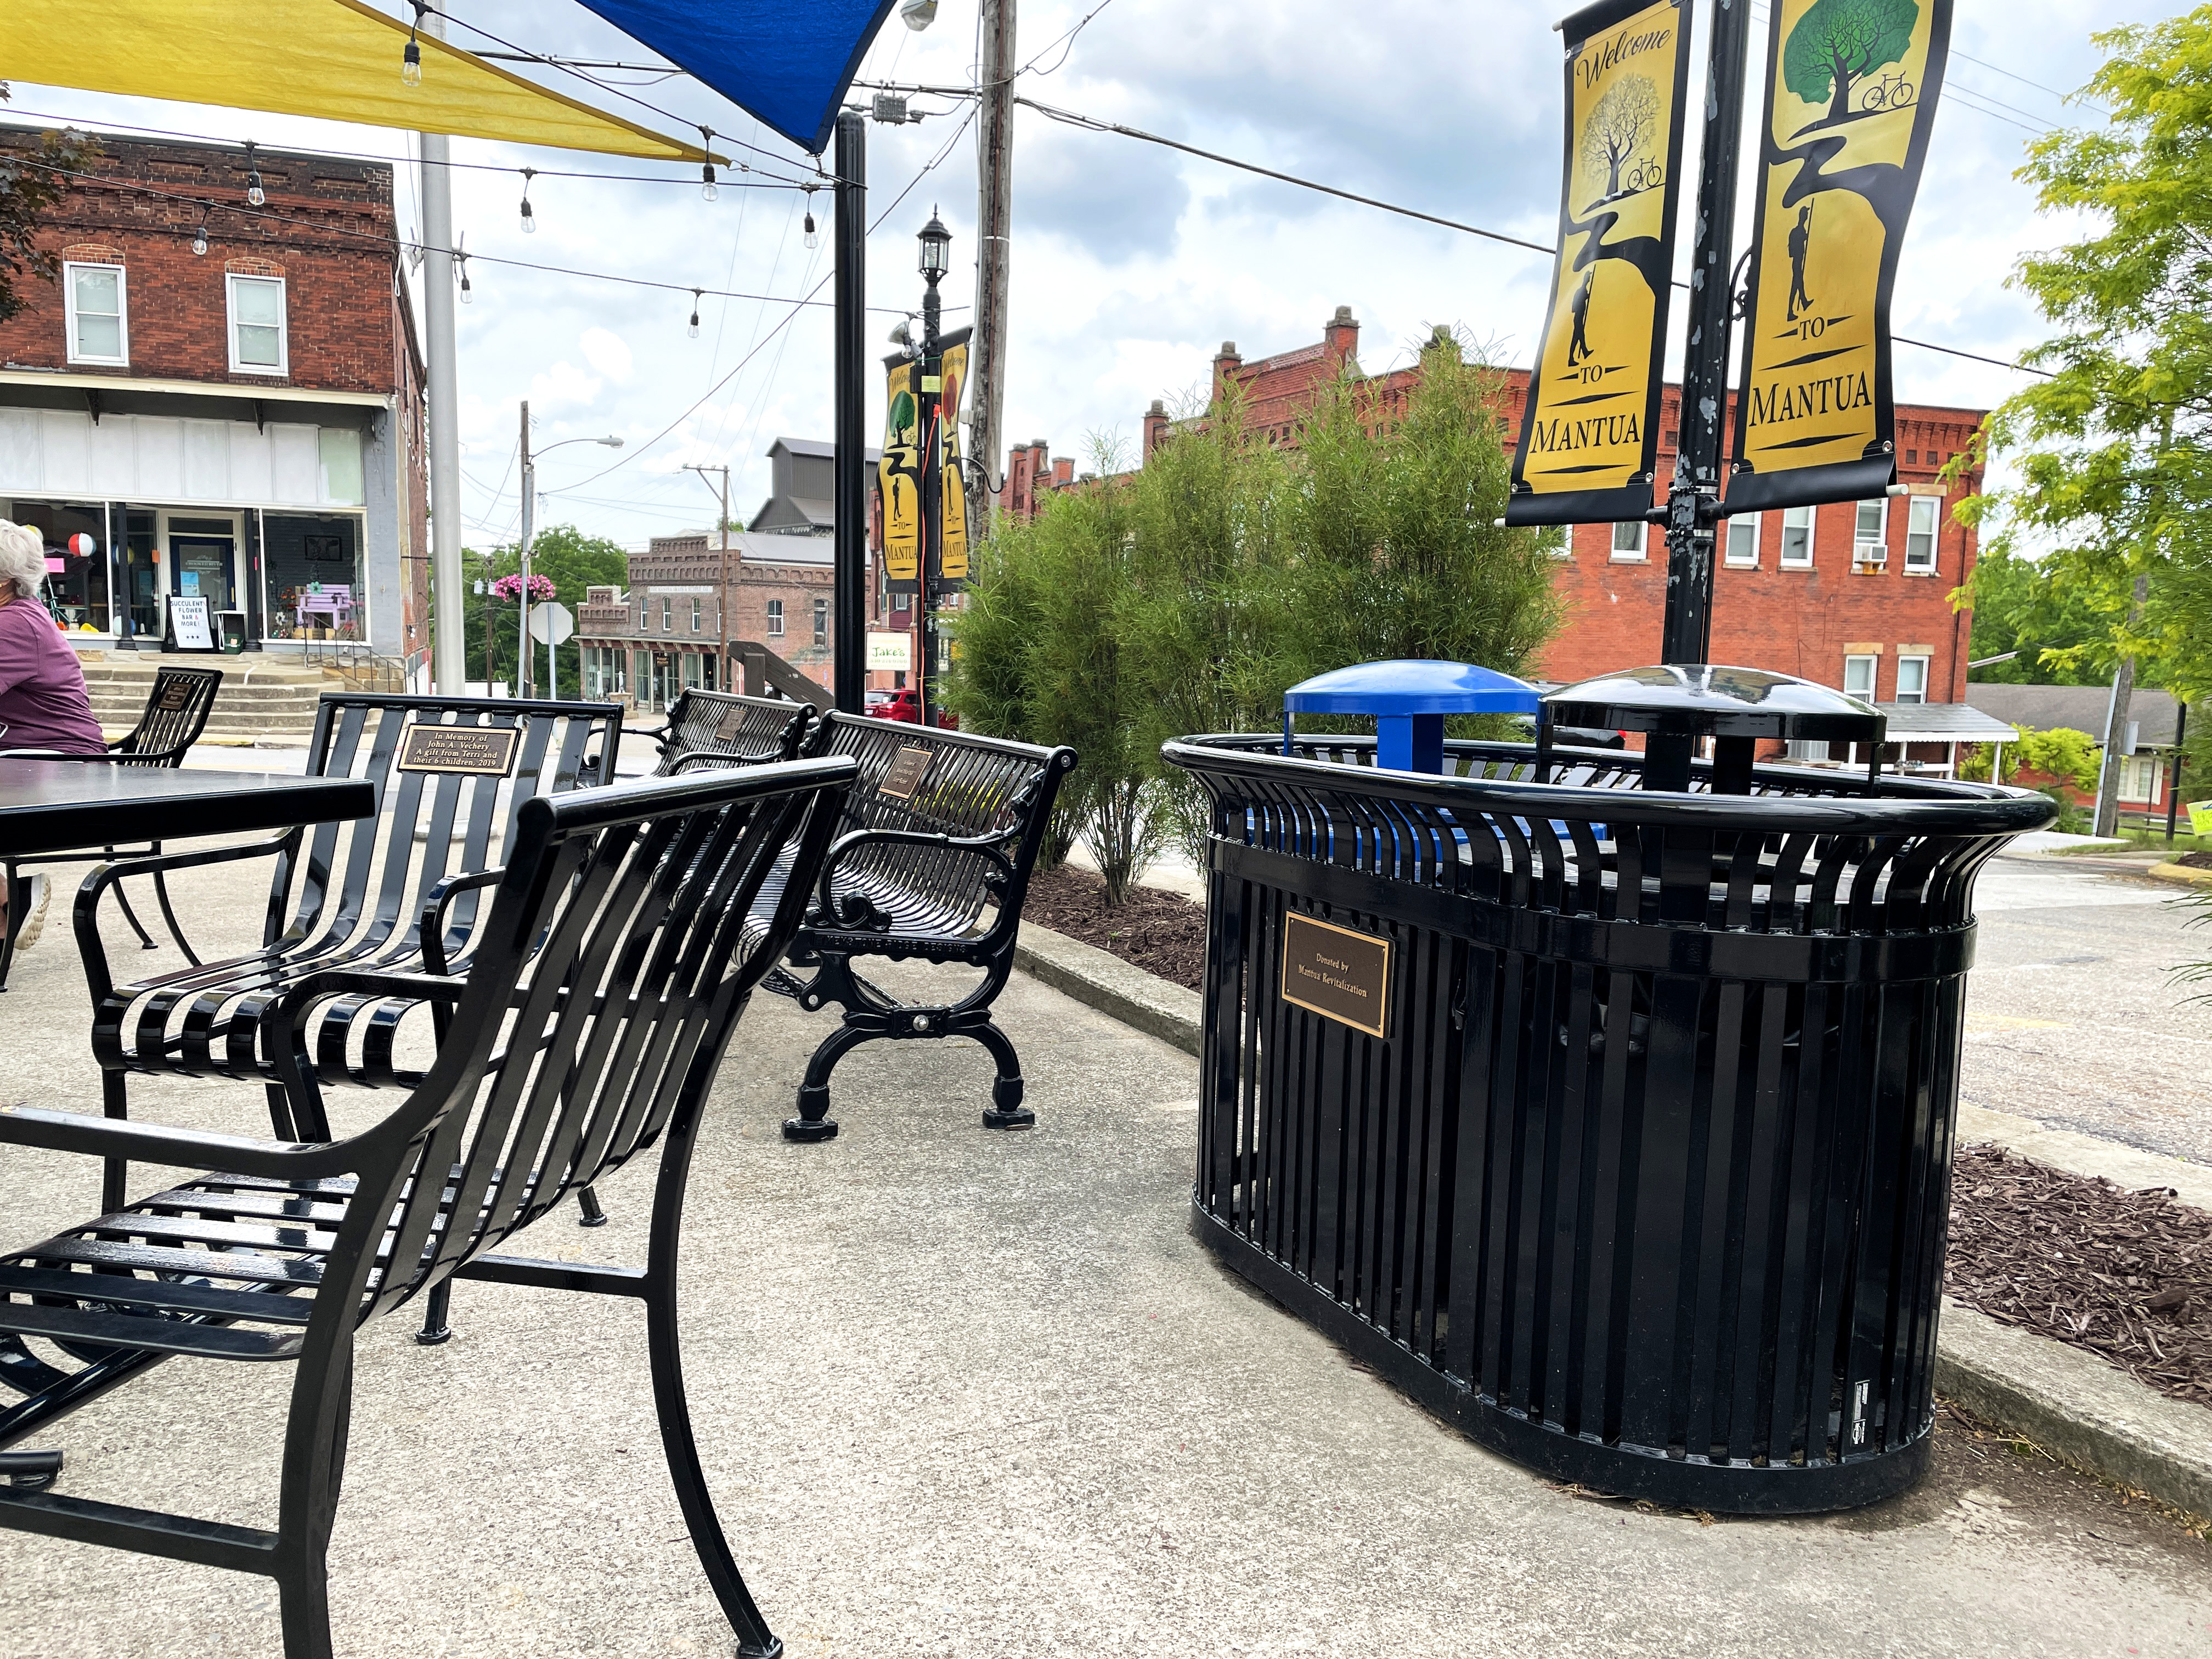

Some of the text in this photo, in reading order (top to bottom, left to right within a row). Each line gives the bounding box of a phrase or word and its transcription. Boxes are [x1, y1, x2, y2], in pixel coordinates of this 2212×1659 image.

[1577, 30, 1673, 89] Welcome
[1799, 317, 1825, 341] TO
[1580, 364, 1603, 384] TO
[1749, 370, 1872, 427] MANTUA
[1530, 413, 1641, 453] MANTUA
[898, 522, 906, 530] TO
[885, 544, 918, 560] MANTUA
[943, 540, 966, 558] MANTUA
[872, 647, 905, 657] Jake's
[445, 733, 476, 743] Memory
[460, 742, 489, 752] Vechery
[424, 749, 438, 757] gift
[441, 758, 476, 766] children,
[1316, 953, 1350, 974] Donated by
[1298, 964, 1368, 998] Mantua Revitalization
